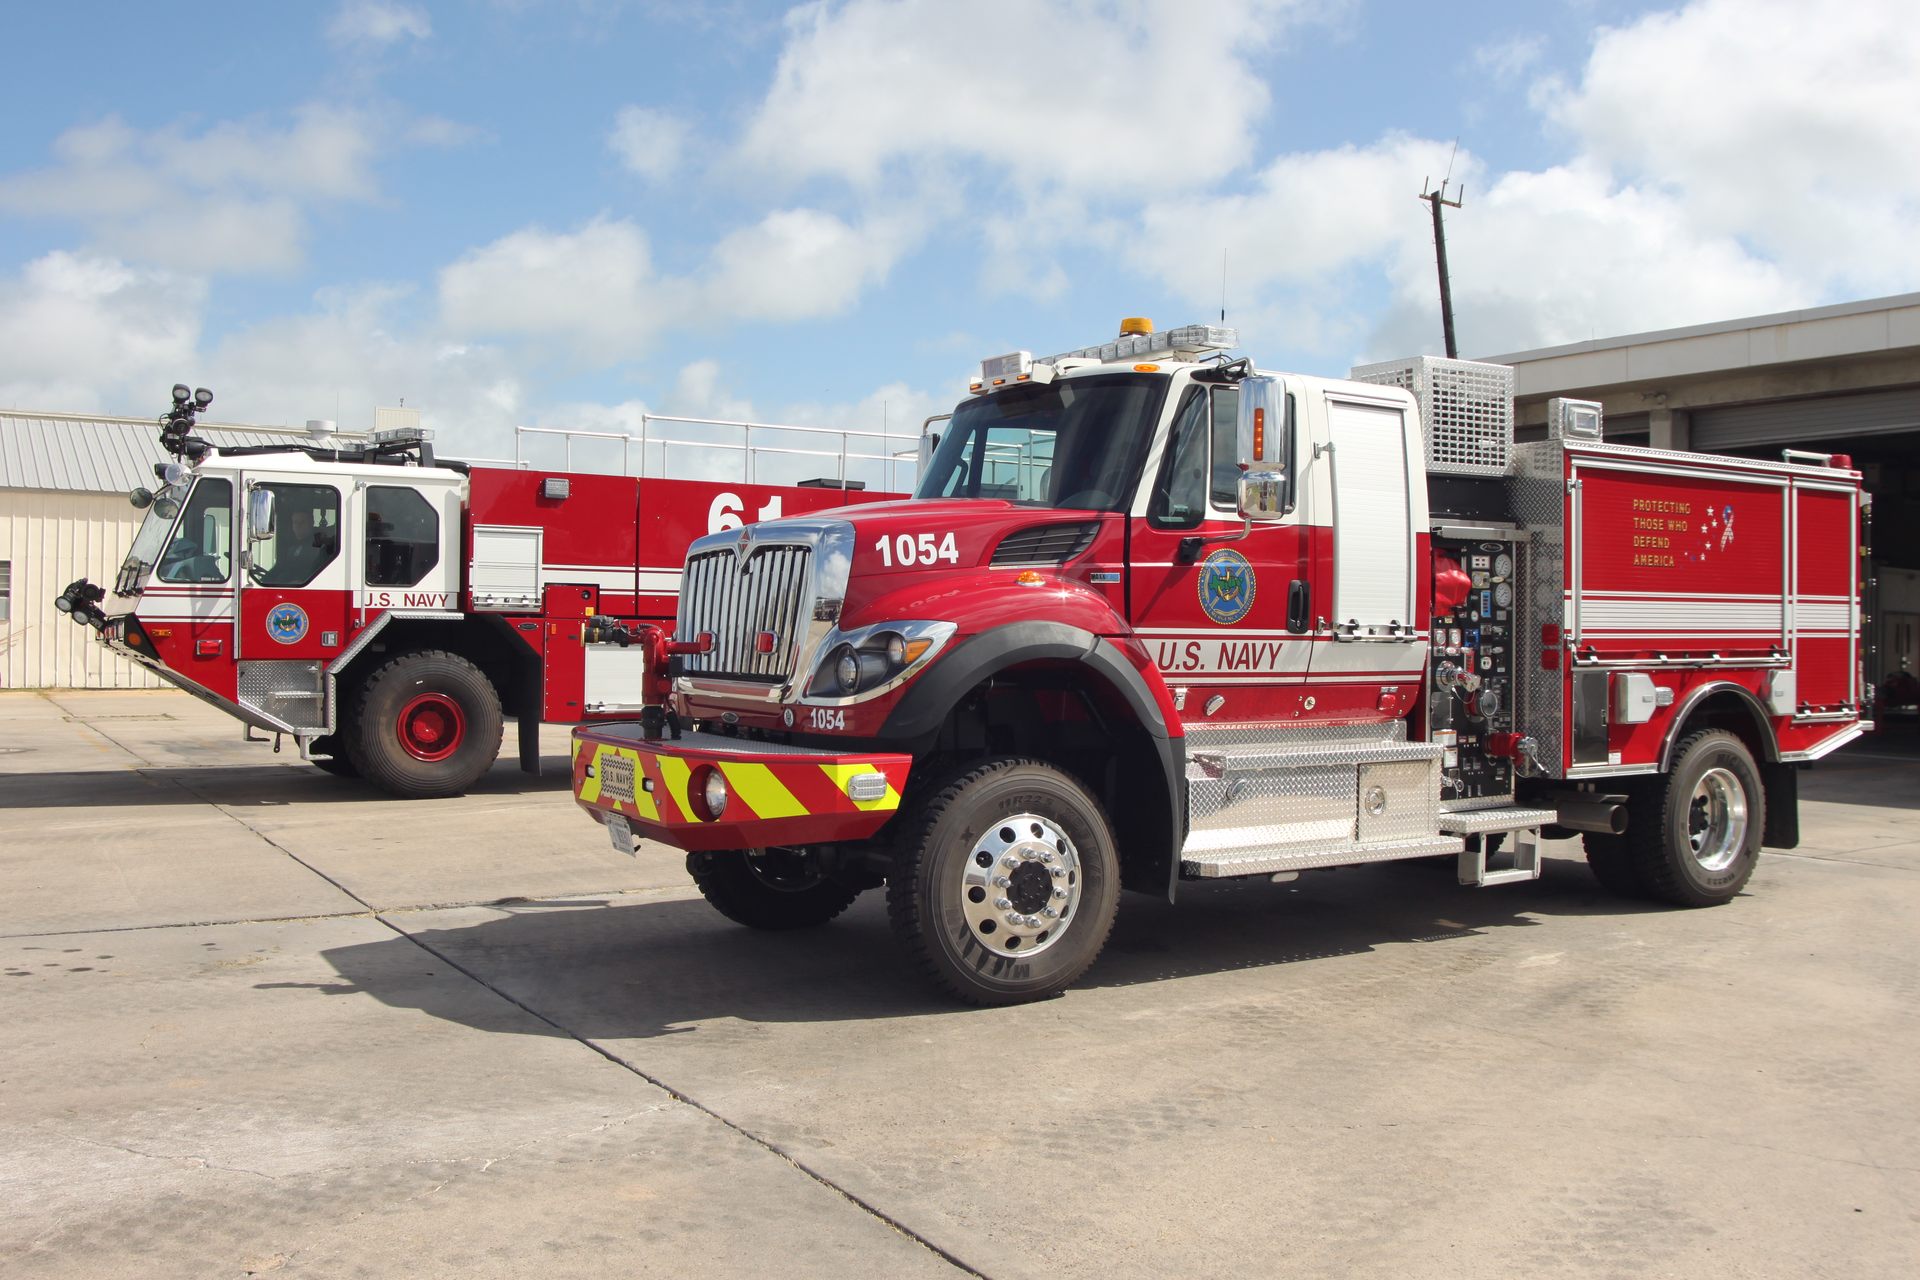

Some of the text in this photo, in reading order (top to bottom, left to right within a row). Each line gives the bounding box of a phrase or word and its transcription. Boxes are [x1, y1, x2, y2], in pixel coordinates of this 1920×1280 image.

[1633, 499, 1691, 514] PROTECTING
[1633, 517, 1688, 532] THOSE WHO
[875, 532, 959, 567] 1054
[1633, 535, 1670, 549] DEFEND
[1633, 554, 1675, 567] AMERICA
[404, 593, 449, 607] NAVY
[1157, 641, 1283, 671] U.S. NAVY
[810, 708, 845, 730] 1054
